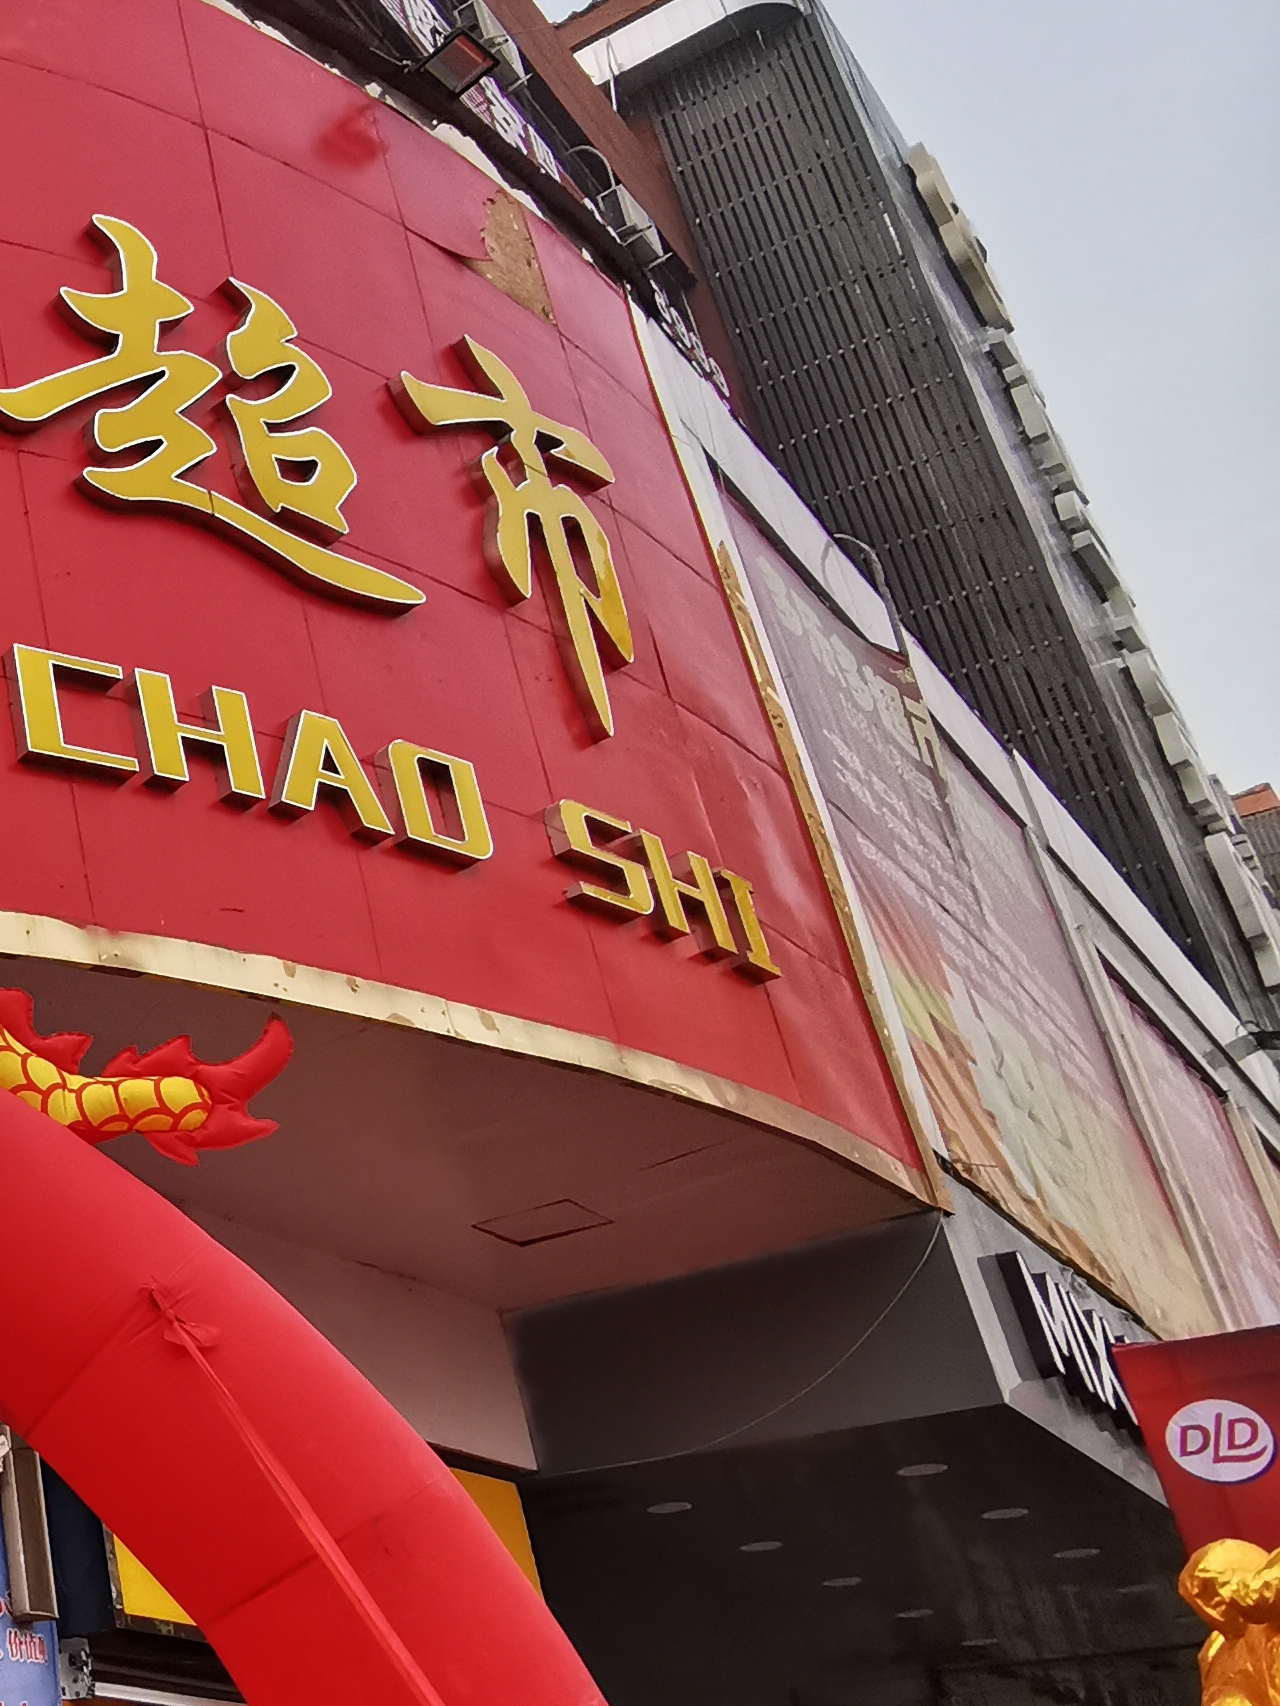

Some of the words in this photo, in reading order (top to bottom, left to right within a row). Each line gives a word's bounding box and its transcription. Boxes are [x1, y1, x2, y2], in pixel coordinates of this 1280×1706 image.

[12, 642, 494, 861] CHAO
[554, 798, 781, 981] SHI
[1178, 1412, 1268, 1464] DLD
